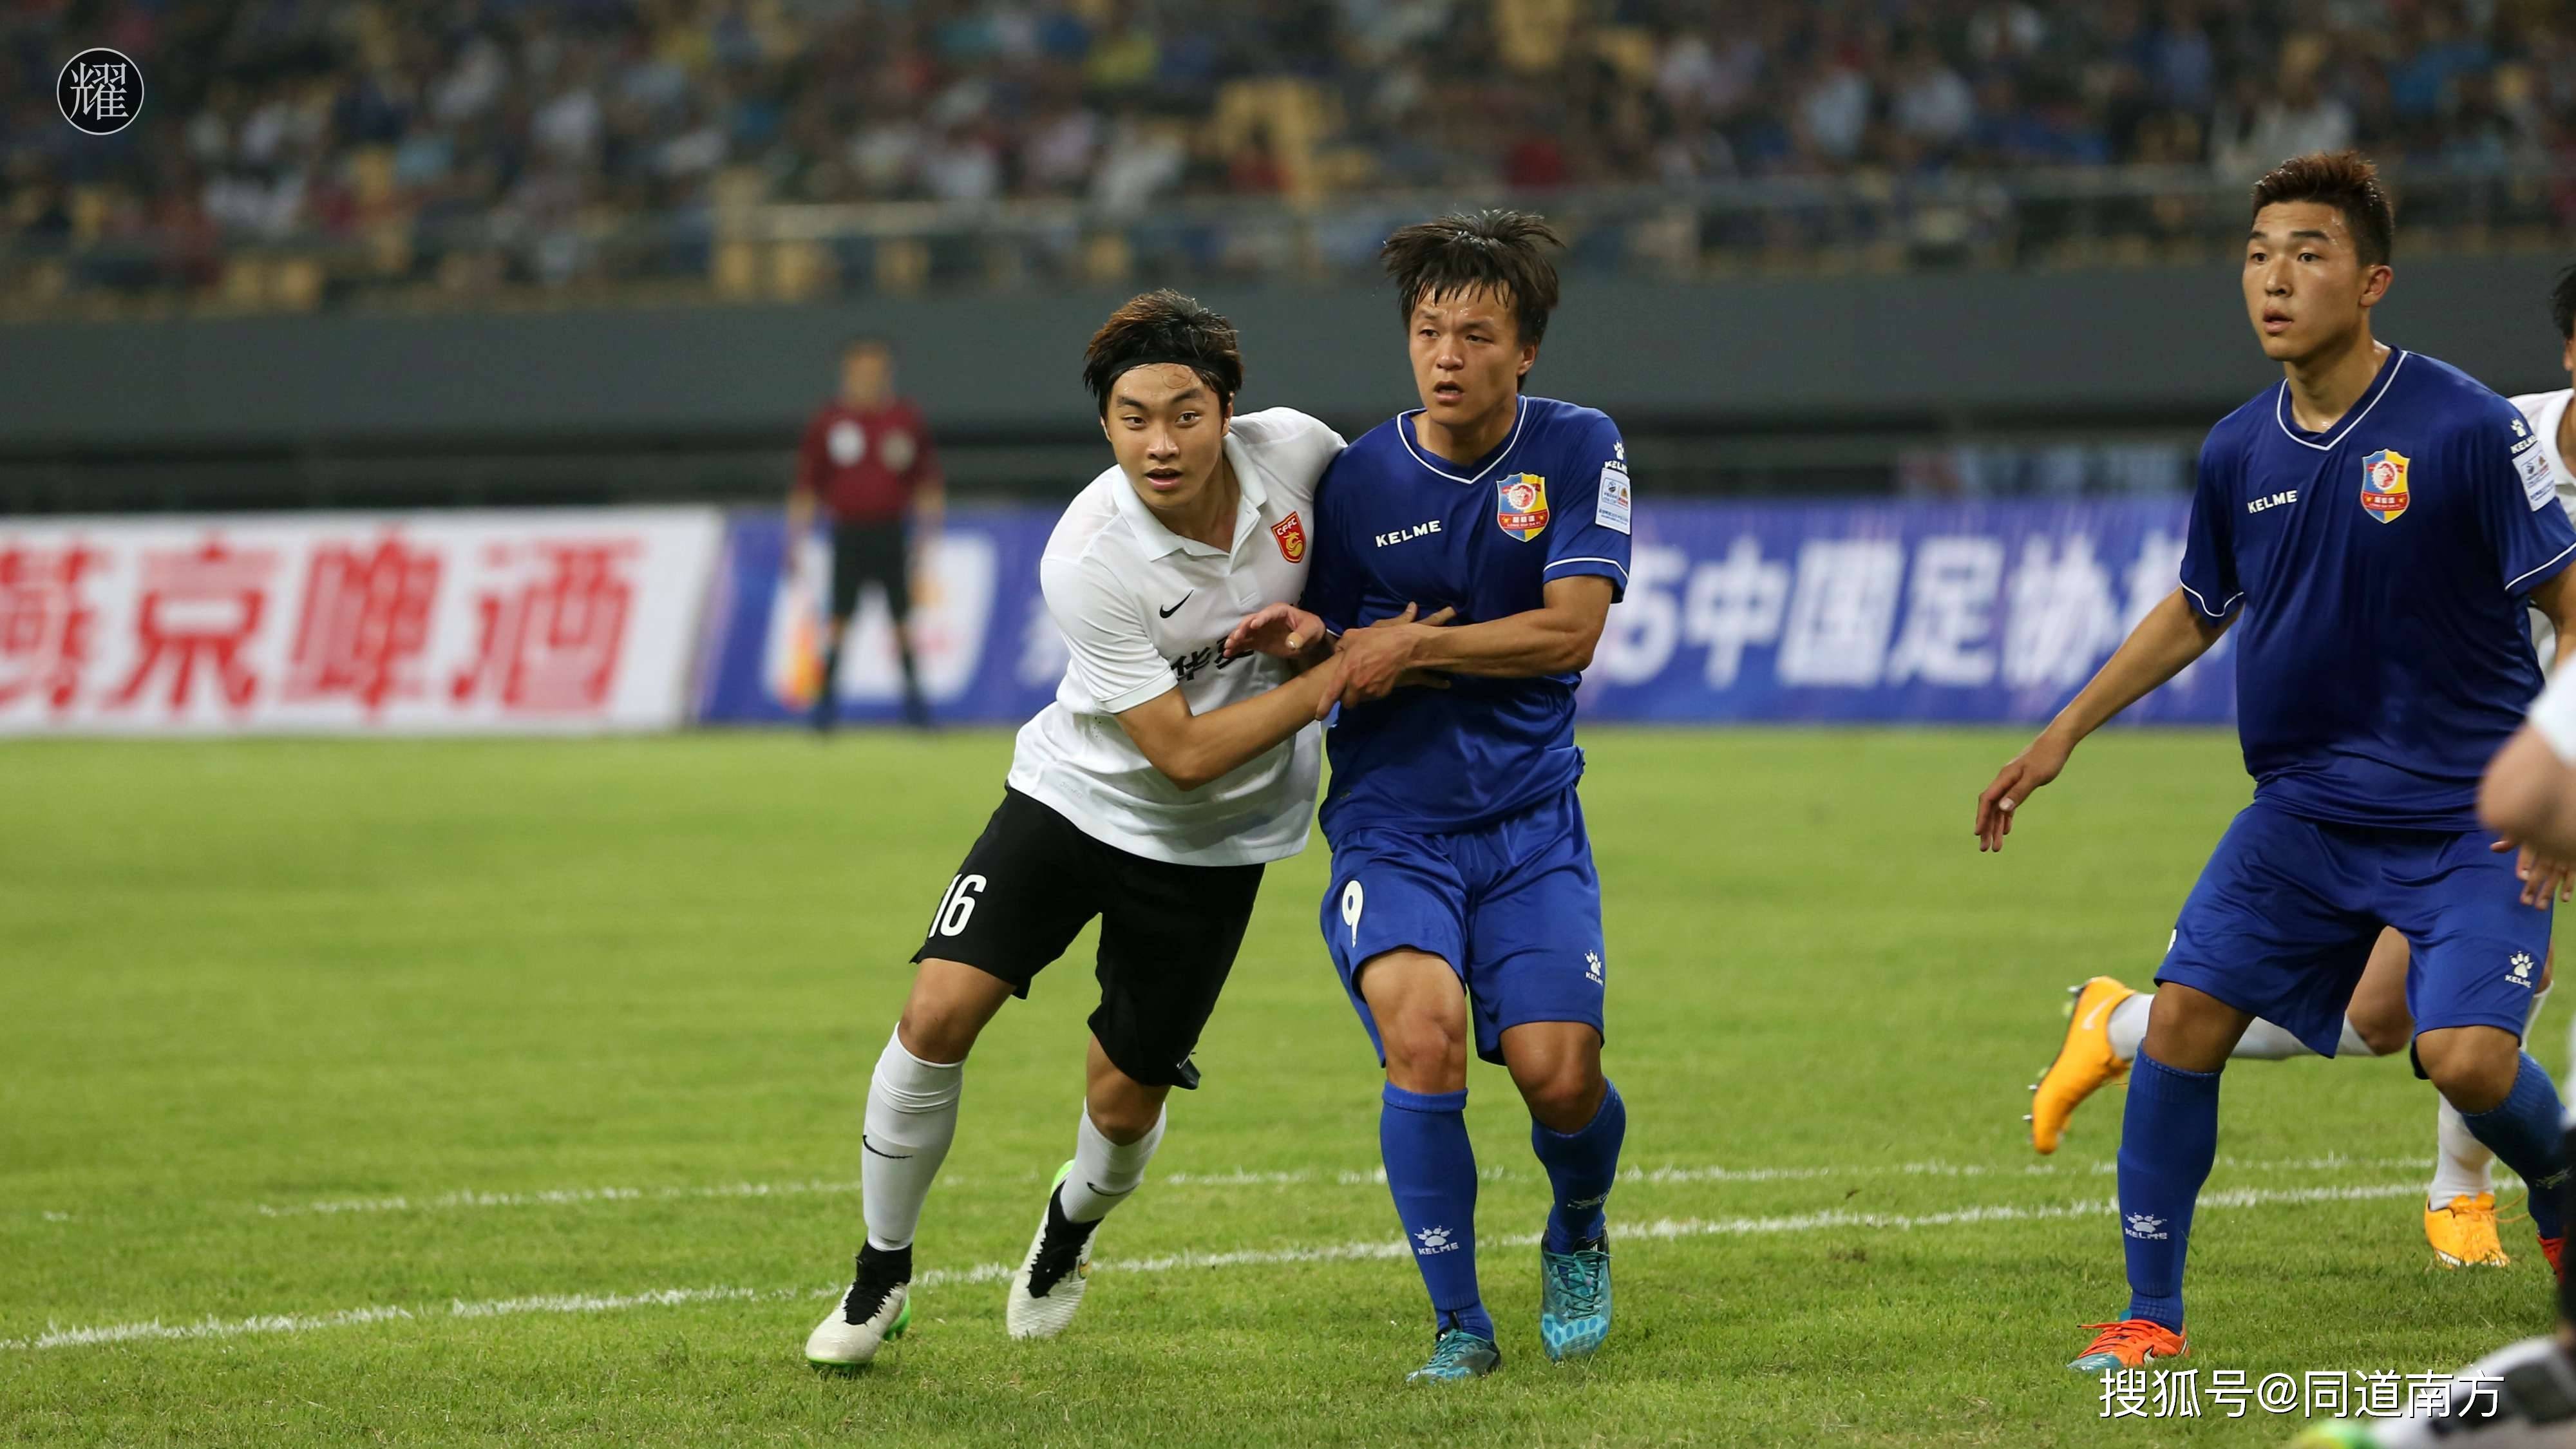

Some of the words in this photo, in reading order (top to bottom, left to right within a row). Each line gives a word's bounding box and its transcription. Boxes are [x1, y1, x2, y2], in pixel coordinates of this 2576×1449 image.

[2510, 435, 2536, 454] KELM
[1604, 460, 1628, 475] KELM
[2247, 489, 2298, 514] KELME
[1375, 520, 1442, 548] KELME
[928, 873, 988, 938] 16
[1341, 880, 1364, 949] 9
[2125, 1227, 2168, 1240] KELME
[1417, 1242, 1459, 1255] KELME
